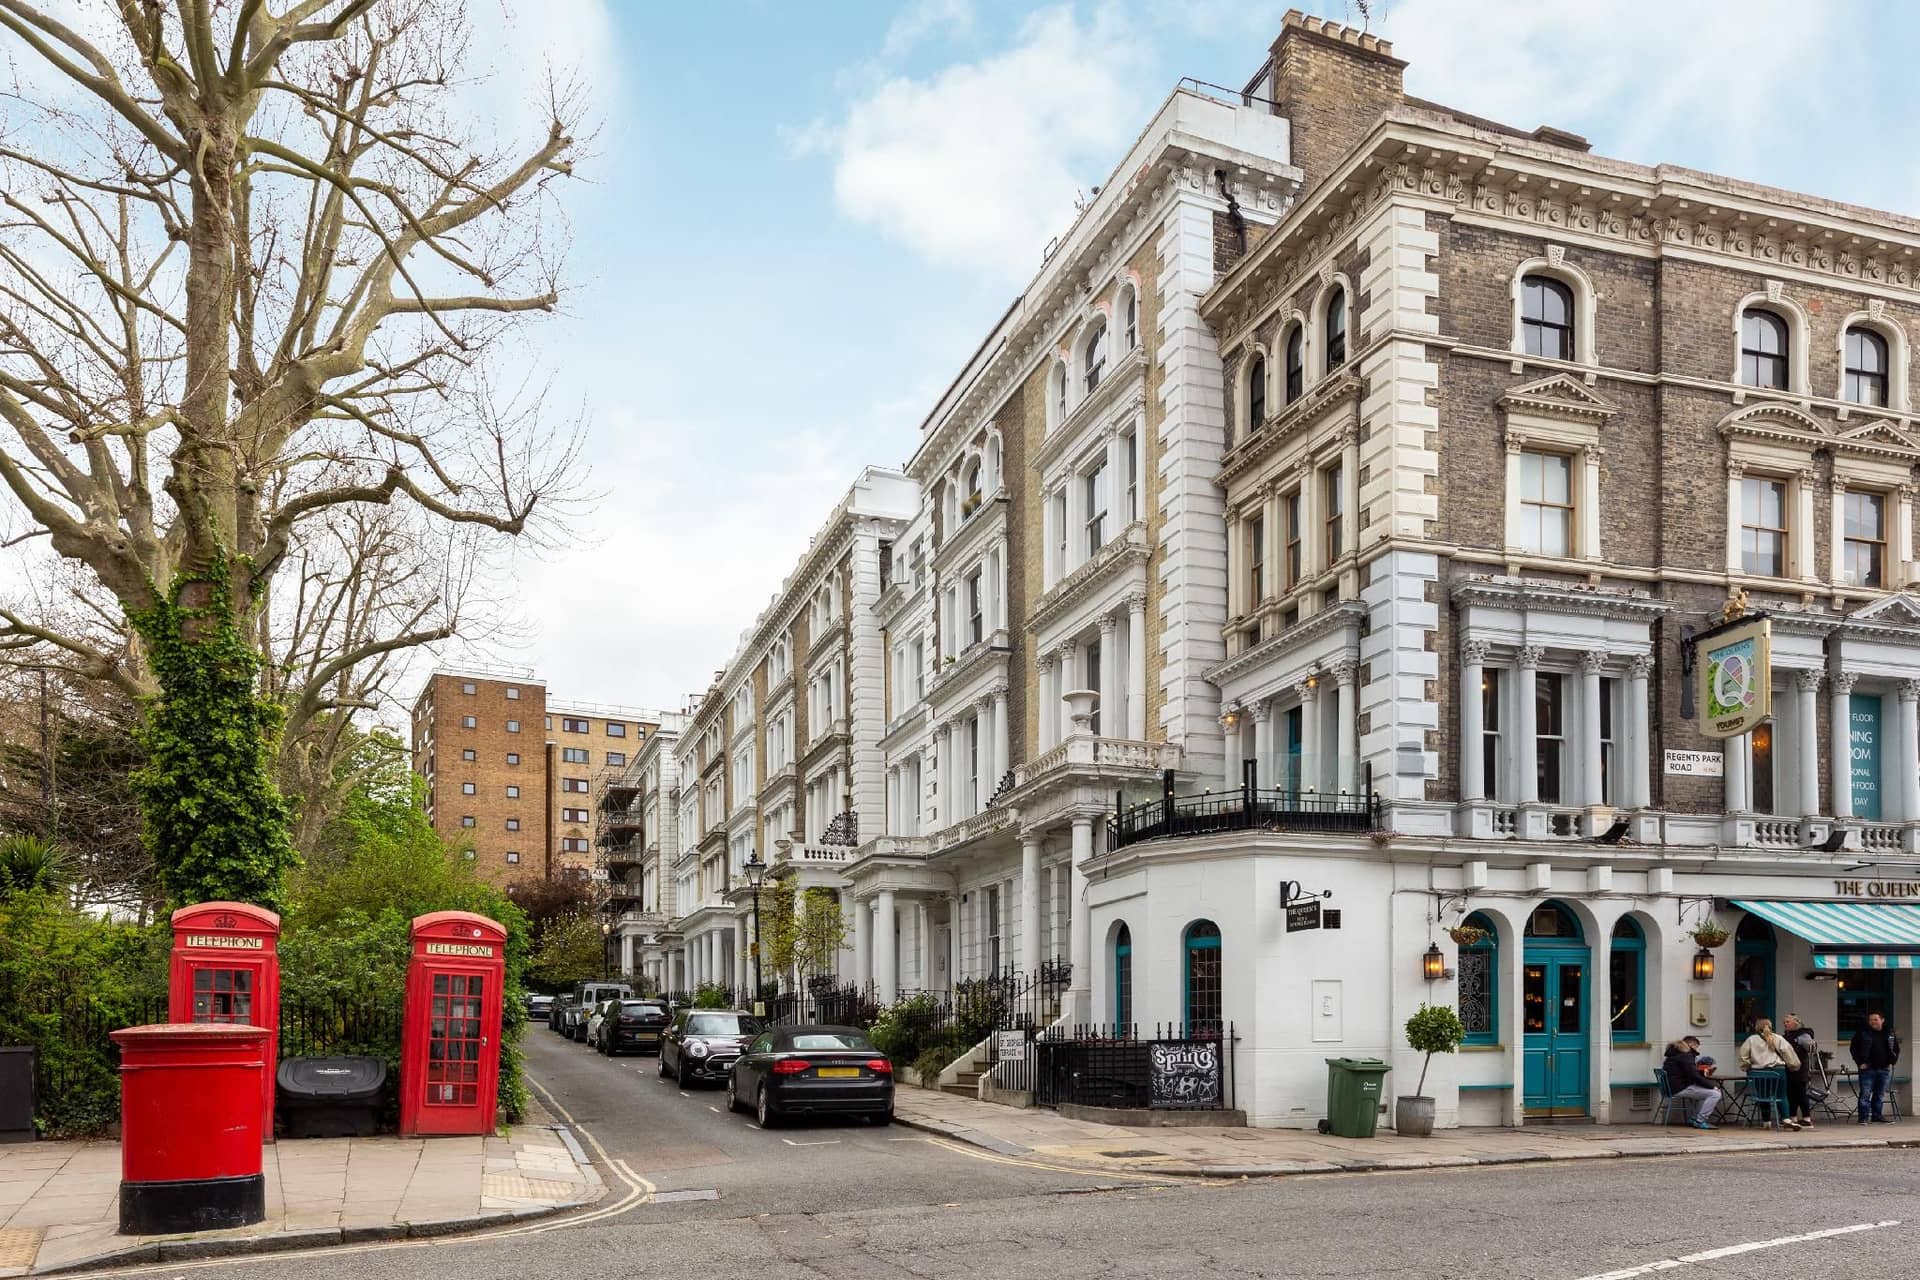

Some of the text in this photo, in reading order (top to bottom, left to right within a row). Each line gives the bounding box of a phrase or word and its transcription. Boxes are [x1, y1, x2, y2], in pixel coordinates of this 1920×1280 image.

[1666, 752, 1721, 763] REGENTS PARK
[1670, 763, 1692, 771] ROAD
[1834, 880, 1864, 896] THE
[189, 935, 261, 948] TELEPHONE
[429, 943, 492, 956] TELEPHONE
[1155, 1049, 1213, 1071] Spring
